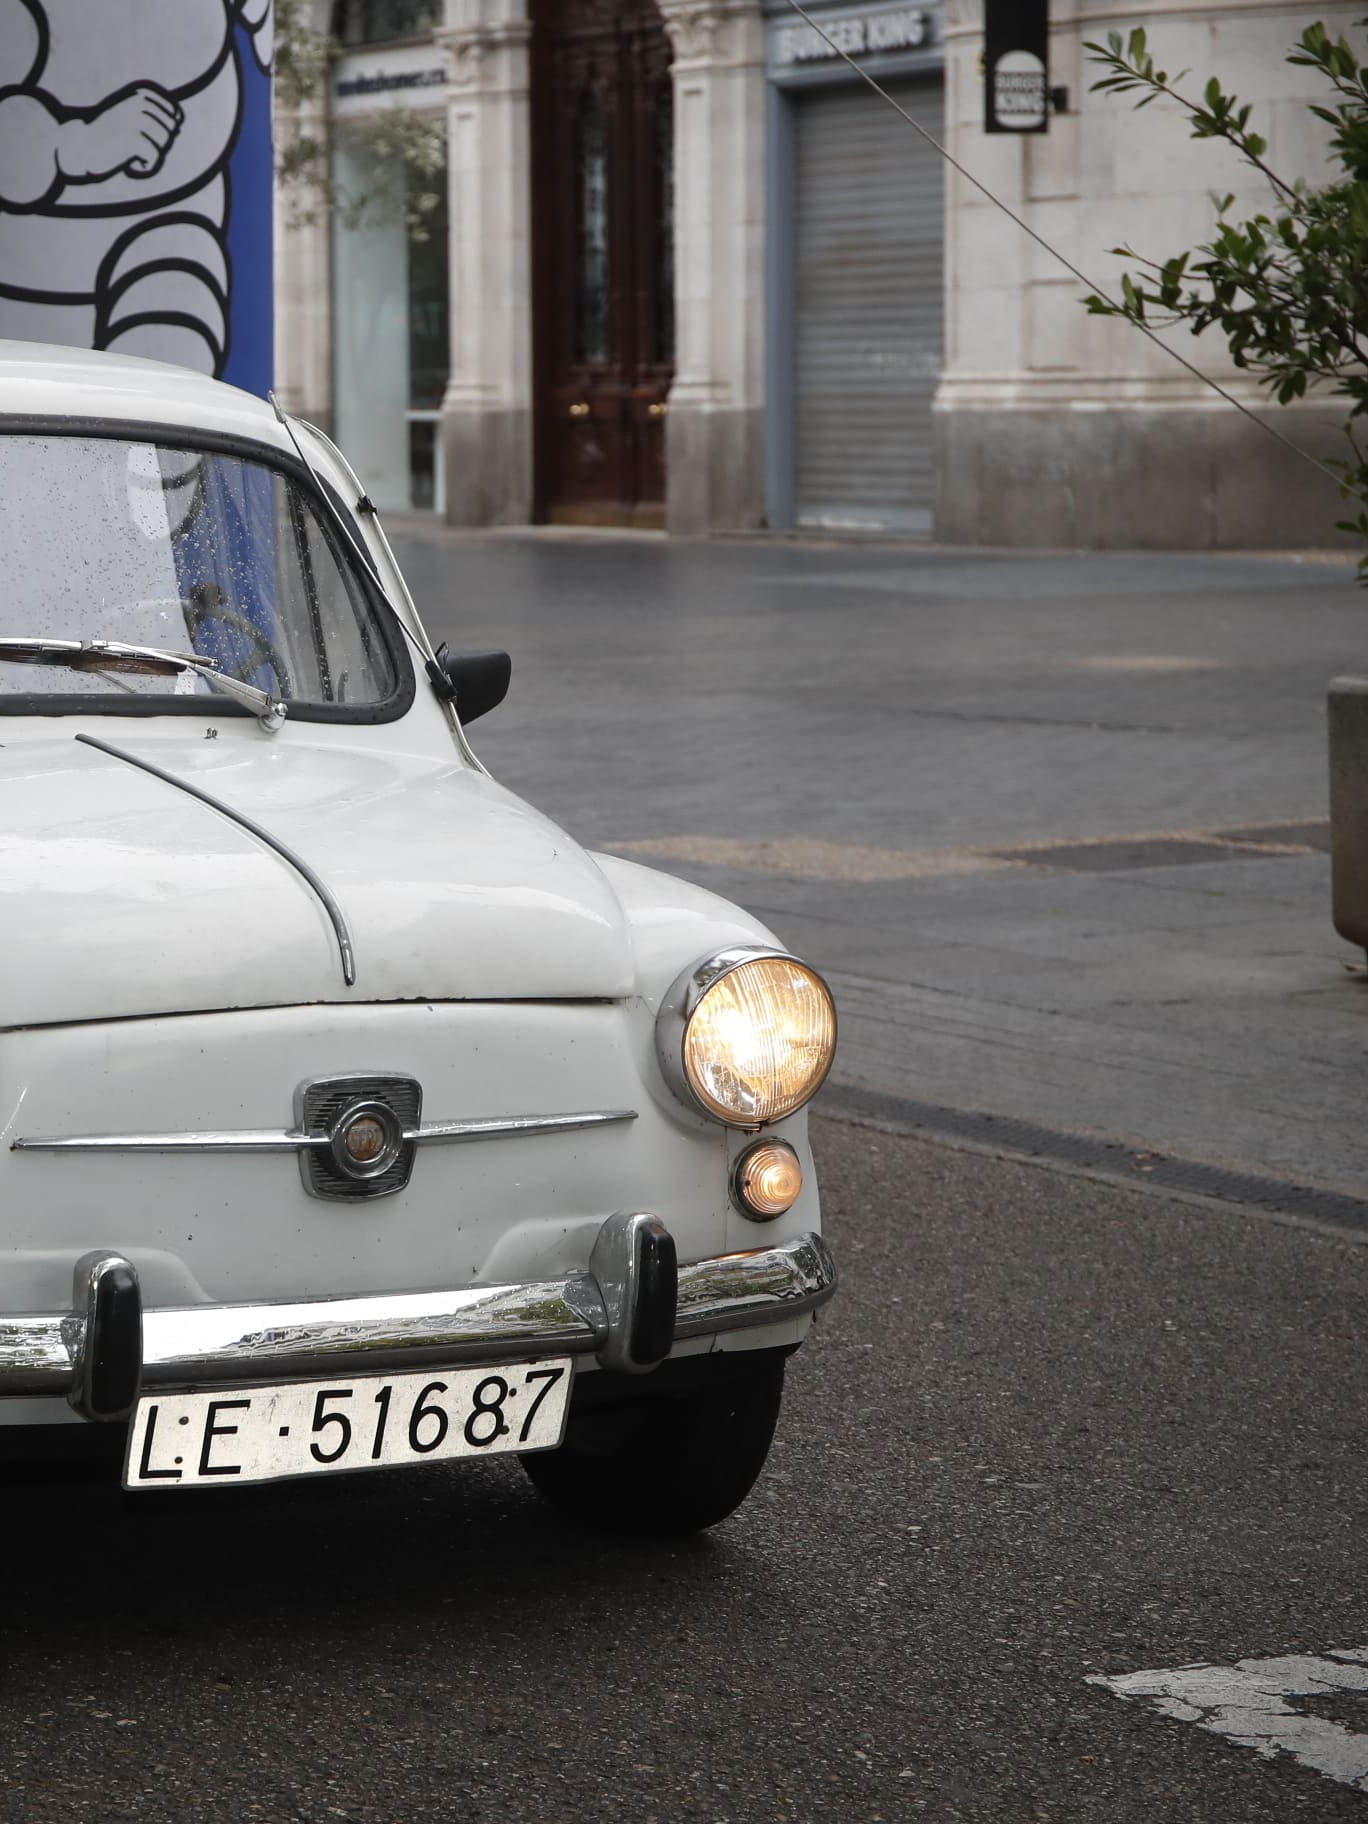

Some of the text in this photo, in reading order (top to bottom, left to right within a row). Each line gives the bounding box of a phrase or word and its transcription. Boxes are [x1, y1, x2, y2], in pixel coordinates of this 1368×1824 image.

[866, 10, 924, 51] KING
[996, 75, 1045, 89] BURGER
[996, 92, 1045, 112] KING
